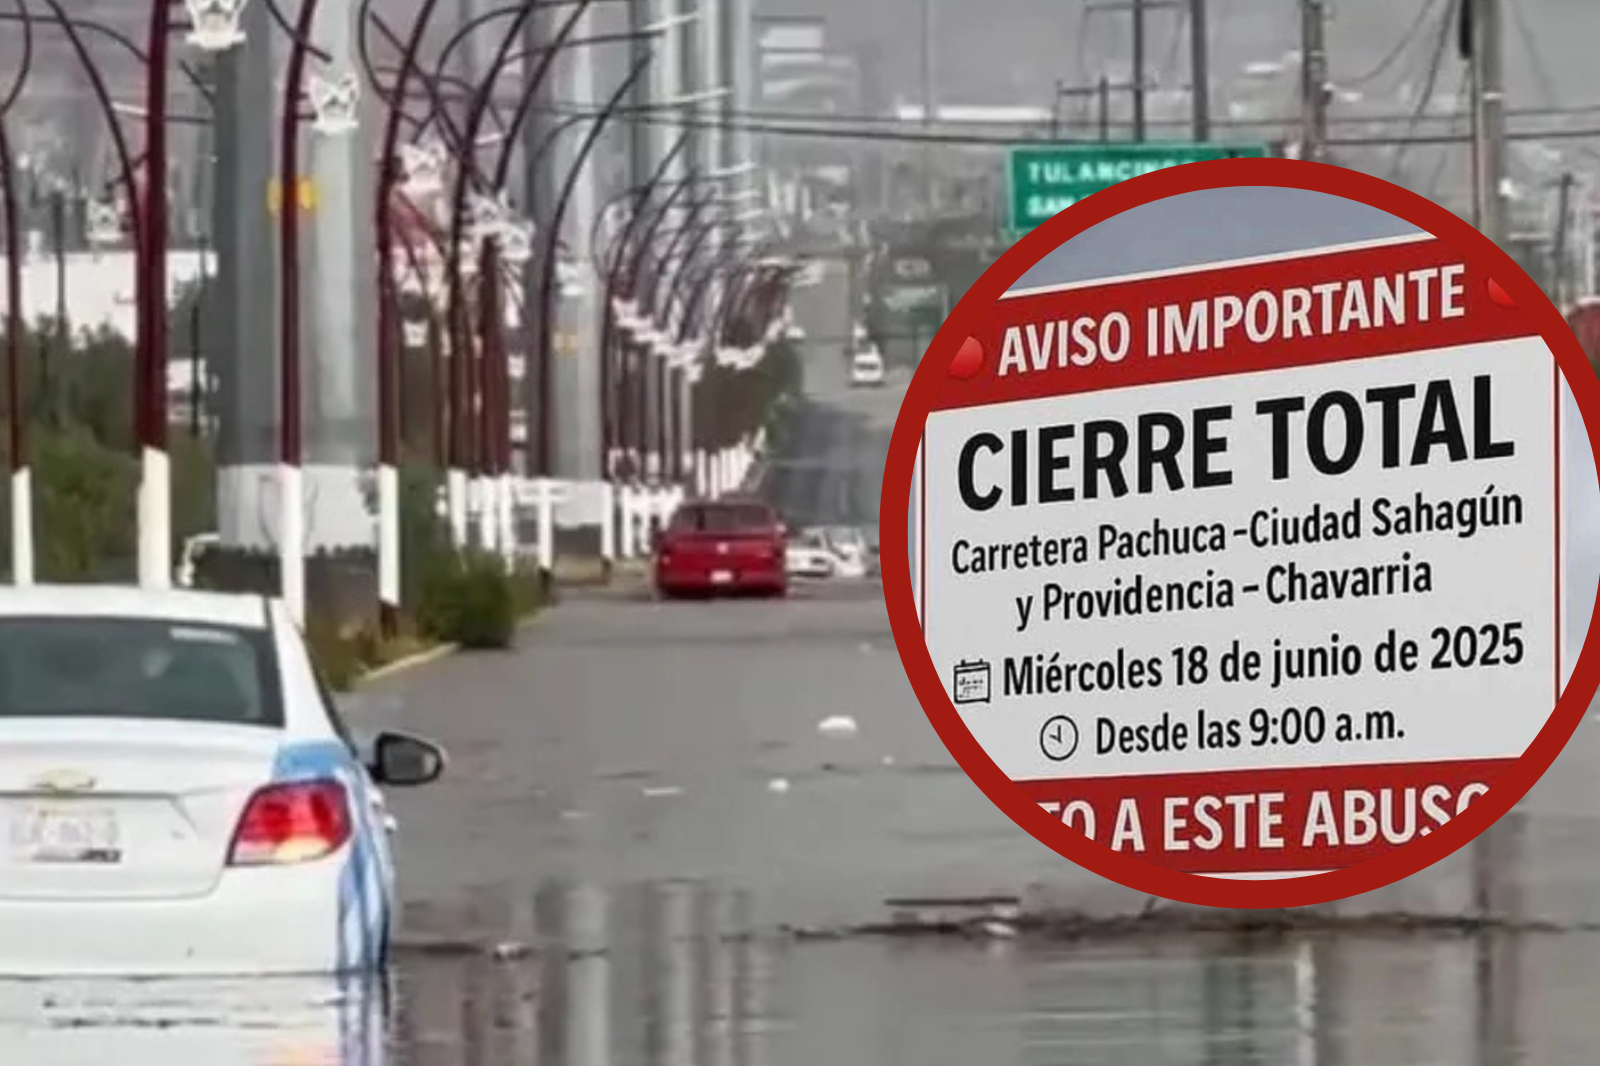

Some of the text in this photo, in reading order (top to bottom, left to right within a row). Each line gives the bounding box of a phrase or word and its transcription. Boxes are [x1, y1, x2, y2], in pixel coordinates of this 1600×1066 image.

[998, 263, 1465, 376] AVISO IMPORTANTE
[957, 374, 1515, 512] CIERRE TOTAL
[951, 535, 1088, 575] Carretera
[1098, 517, 1226, 561] Pachuca
[1372, 483, 1523, 539] Sahagún
[1015, 595, 1034, 633] y
[1043, 569, 1234, 621] Providencia
[1266, 551, 1432, 605] Chavarria
[1003, 621, 1524, 696] Miércoles 18 de junio de 2025
[1096, 705, 1405, 755] Desde las 9:00 a.m.
[1110, 798, 1145, 852] A
[1164, 792, 1285, 851] ESTE
